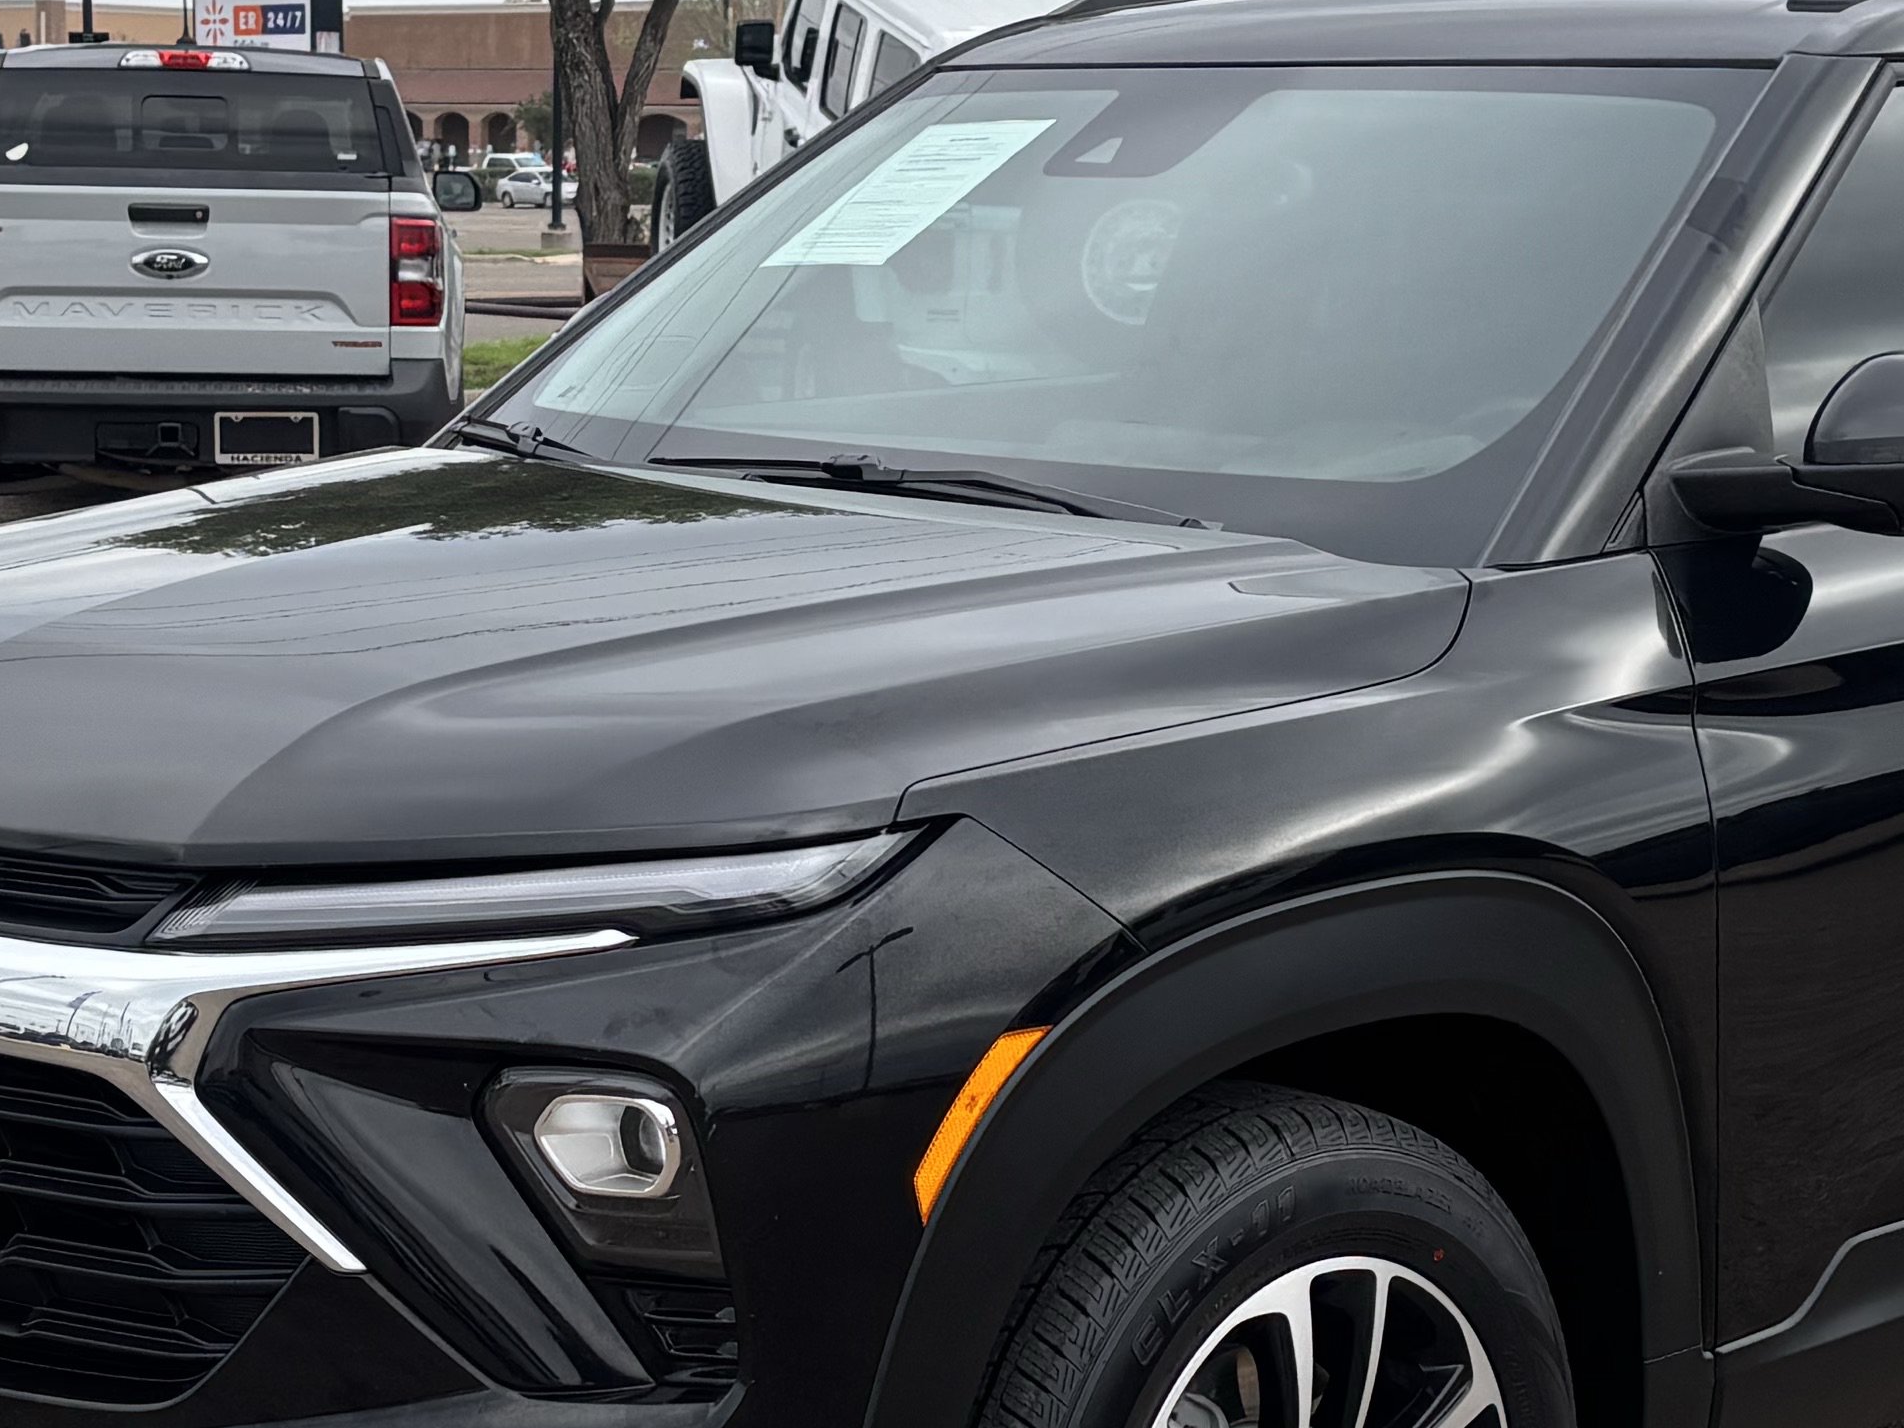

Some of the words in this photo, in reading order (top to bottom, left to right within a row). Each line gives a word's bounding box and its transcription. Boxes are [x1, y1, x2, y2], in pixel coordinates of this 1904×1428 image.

[239, 10, 256, 30] ER
[267, 10, 302, 29] 24/7
[12, 301, 324, 321] MAVERICK
[231, 455, 303, 463] HACIENDA
